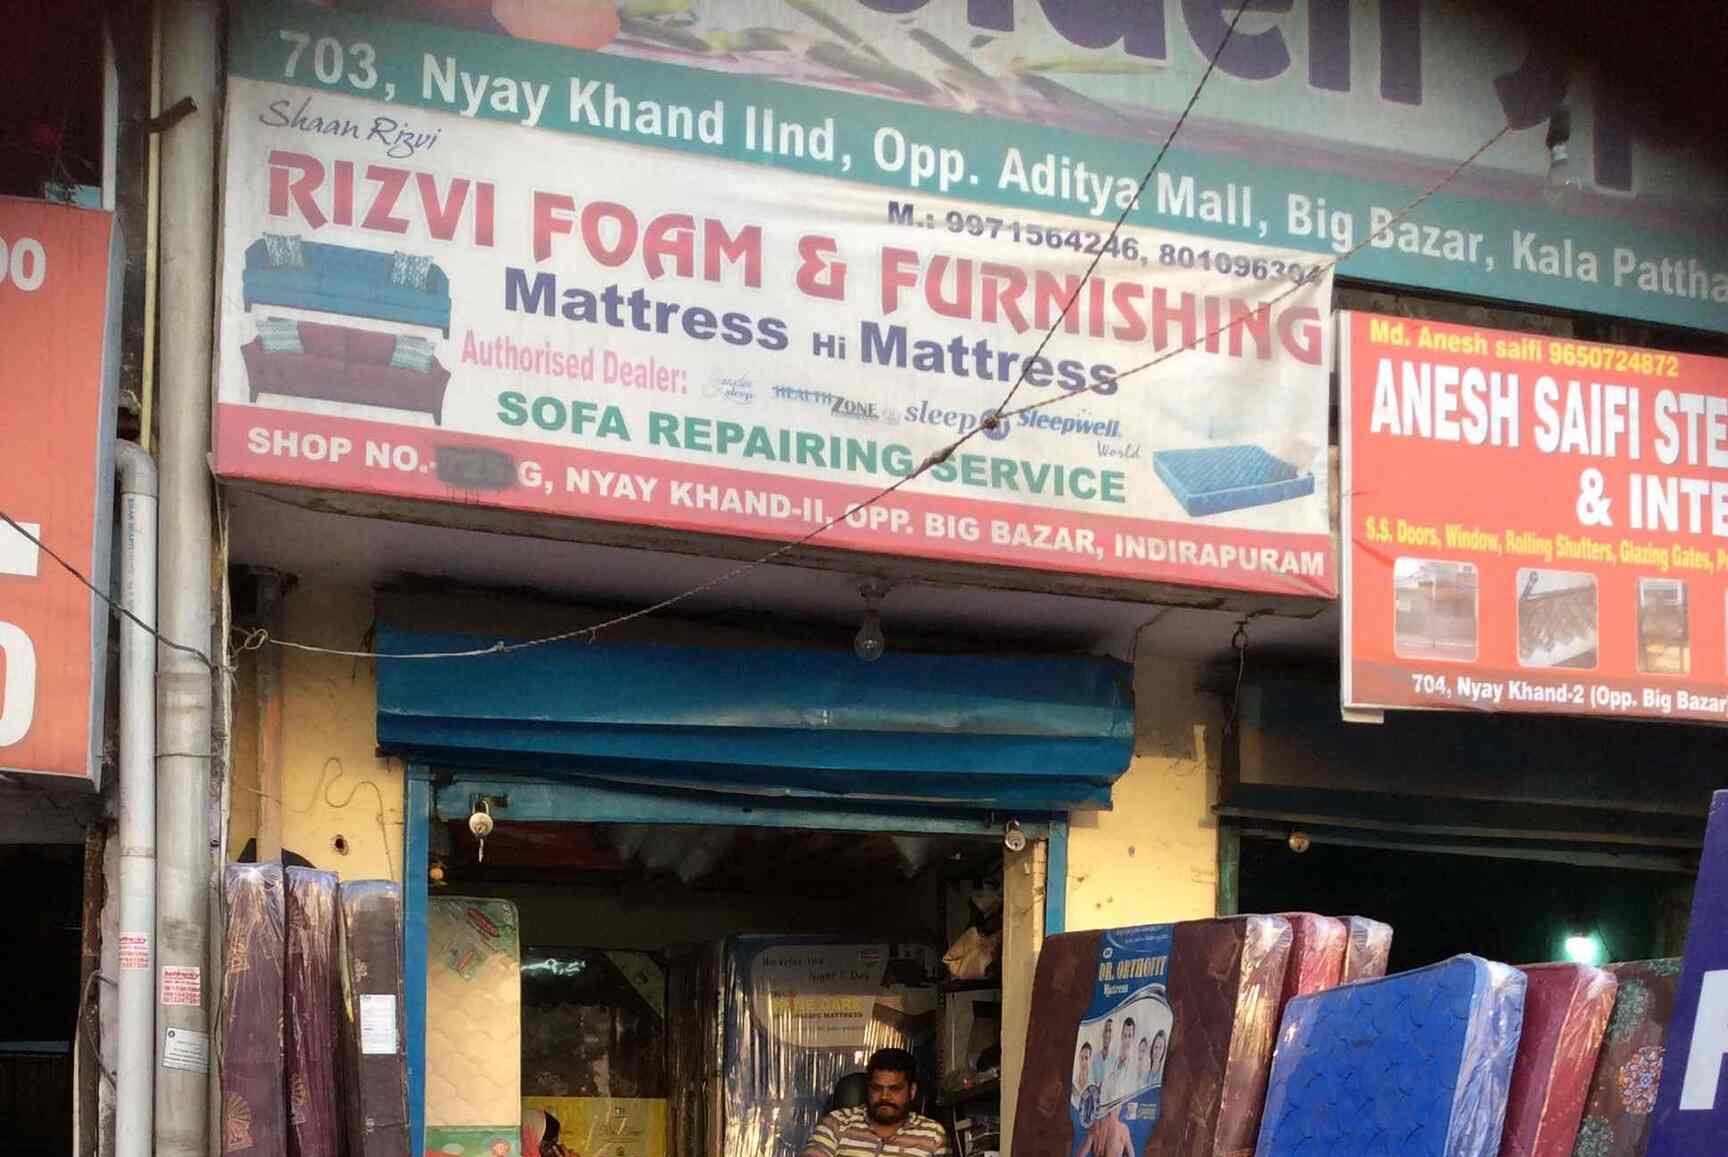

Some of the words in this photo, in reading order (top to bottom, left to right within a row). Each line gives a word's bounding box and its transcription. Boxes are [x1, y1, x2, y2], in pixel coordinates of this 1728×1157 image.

[259, 97, 362, 141] Shaan
[367, 117, 442, 158] Rizvi
[279, 29, 397, 102] 703,
[422, 52, 550, 127] Nyay
[569, 77, 724, 146] Khand
[874, 126, 979, 192] Opp.
[998, 147, 1140, 215] Aditya
[1158, 172, 1268, 238] Mall,
[1287, 193, 1353, 253] Big
[1370, 206, 1496, 272] Bazar,
[1512, 230, 1598, 283] Kala
[268, 150, 496, 248] RIZVI
[532, 190, 763, 289] FOAM
[797, 234, 848, 302] &
[880, 246, 1324, 367] FURNISHING
[945, 210, 1148, 268] 9971564246,
[504, 267, 789, 351] Mattress
[812, 329, 846, 361] Hi
[860, 321, 1119, 395] Mattress
[1369, 318, 1411, 347] Md.
[1417, 327, 1489, 358] Anesh
[1495, 336, 1542, 365] saifi
[1549, 343, 1680, 377] 9650724872
[461, 330, 595, 383] Authorised
[603, 351, 689, 395] Dealer:
[904, 400, 977, 434] sleep
[1017, 410, 1121, 438] Sleepwell
[1370, 358, 1520, 448] ANESH
[1534, 376, 1641, 461] SAIFI
[1654, 389, 1728, 470] STE
[497, 391, 631, 442] SOFA
[649, 410, 915, 479] REPAIRING
[930, 450, 1127, 504] SERVICE
[248, 427, 354, 464] SHOP
[565, 467, 658, 505] NYAY
[669, 481, 833, 530] KHAND-II,
[844, 507, 914, 536] OPP.
[925, 512, 982, 542] BIG
[991, 522, 1105, 562] BAZAR,
[1115, 533, 1326, 578] INDIRAPURAM
[1576, 468, 1614, 527] &
[1365, 516, 1393, 541] S.S.
[1397, 519, 1442, 551] Doors,
[1445, 523, 1502, 555] Window,
[1505, 530, 1553, 563] Rolling
[1412, 673, 1452, 700] 704,
[1456, 676, 1504, 702] Nyay
[1508, 680, 1585, 704] Khand-2
[1591, 685, 1637, 710] (Opp.
[1643, 689, 1673, 712] Big
